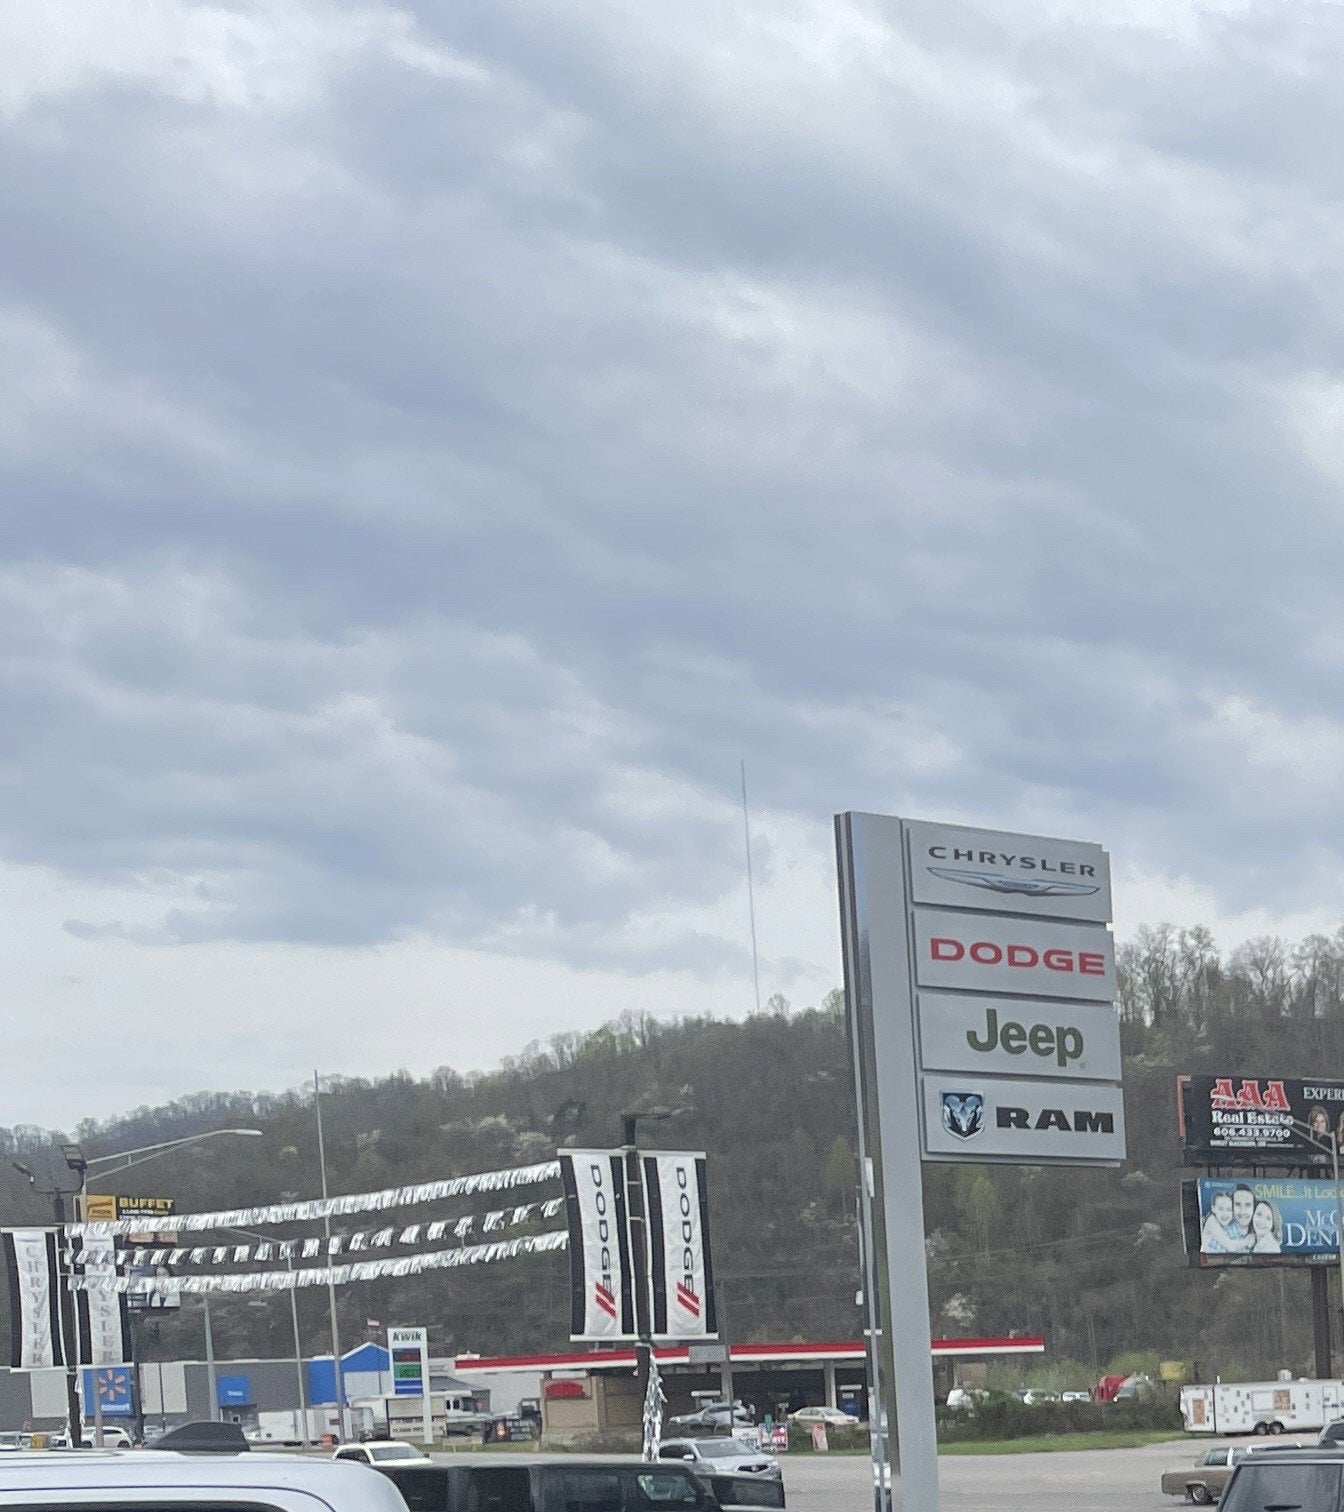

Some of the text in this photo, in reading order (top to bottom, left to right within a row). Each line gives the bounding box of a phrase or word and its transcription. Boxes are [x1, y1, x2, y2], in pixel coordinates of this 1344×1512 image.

[928, 846, 1095, 877] CHRYSLER
[929, 937, 1106, 976] DODGE
[966, 1008, 1084, 1067] Jeep
[1210, 1079, 1291, 1111] AAA
[996, 1106, 1115, 1134] RAM
[1211, 1110, 1244, 1124] Real
[591, 1164, 612, 1295] DODGE
[676, 1167, 694, 1295] DODGE
